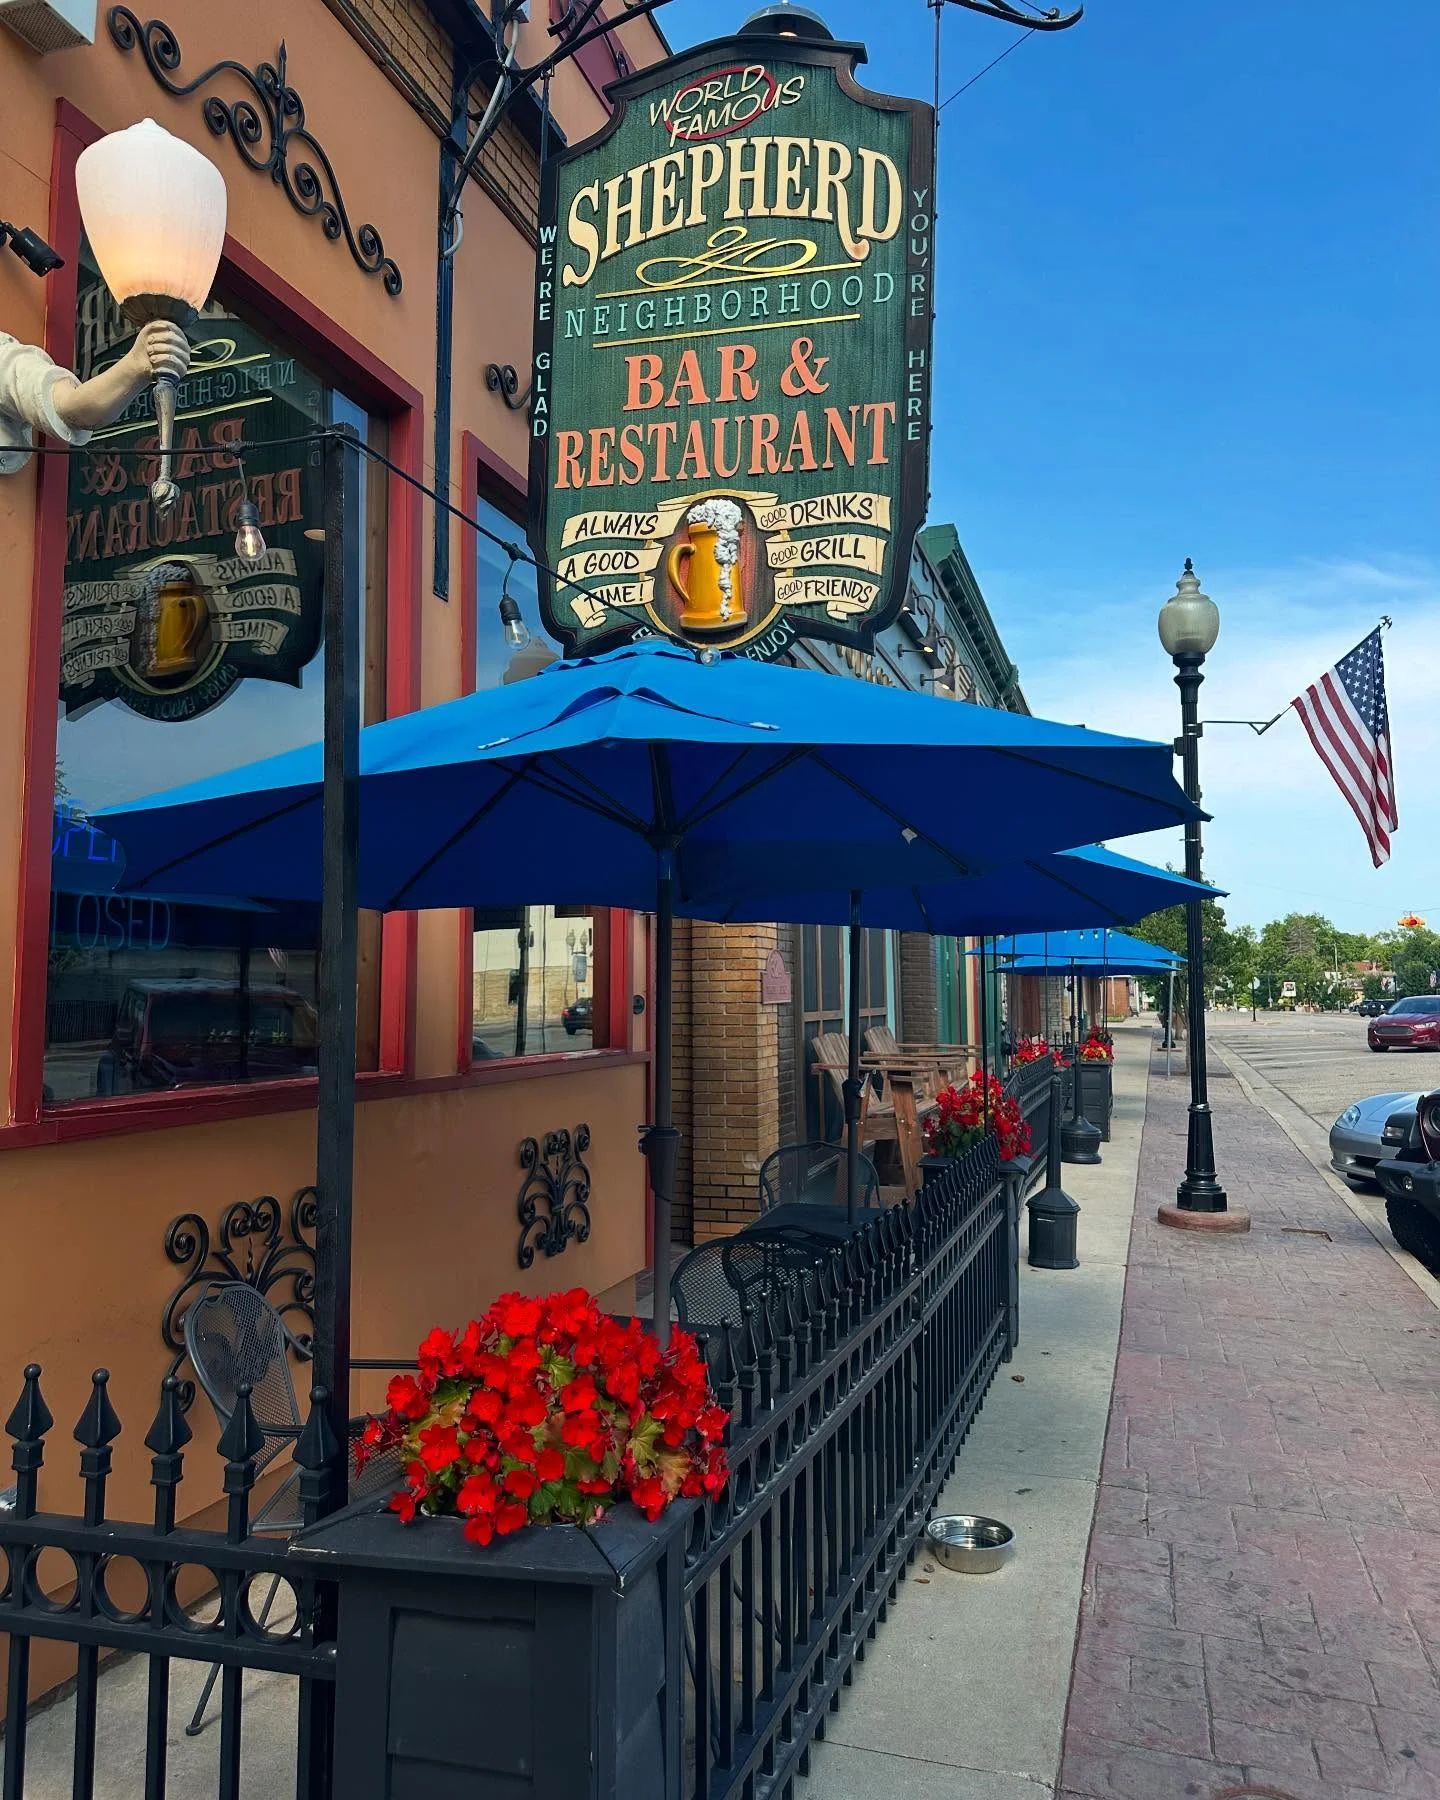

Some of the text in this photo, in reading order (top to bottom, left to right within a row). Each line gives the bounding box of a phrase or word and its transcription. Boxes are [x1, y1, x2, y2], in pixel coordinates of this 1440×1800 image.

[649, 64, 766, 127] WORLD
[669, 75, 804, 148] FAMOUS
[562, 135, 903, 288] SHEPHERD
[539, 225, 557, 321] WE'RE
[909, 188, 929, 317] YOU'RE
[564, 272, 895, 339] NEIGHBORHOOD
[533, 352, 550, 437] GLAD
[622, 336, 830, 412] BAR &
[906, 348, 925, 441] HERE
[554, 402, 896, 490] RESTAURANT
[575, 513, 659, 541] ALWAYS
[760, 494, 874, 527] GOOD DRINKS
[564, 550, 640, 580] A GOOD
[770, 539, 866, 565] GOOD GRILL
[583, 583, 644, 612] TIME!
[777, 579, 873, 604] GOOD FRIENDS
[52, 891, 172, 950] LOSED
